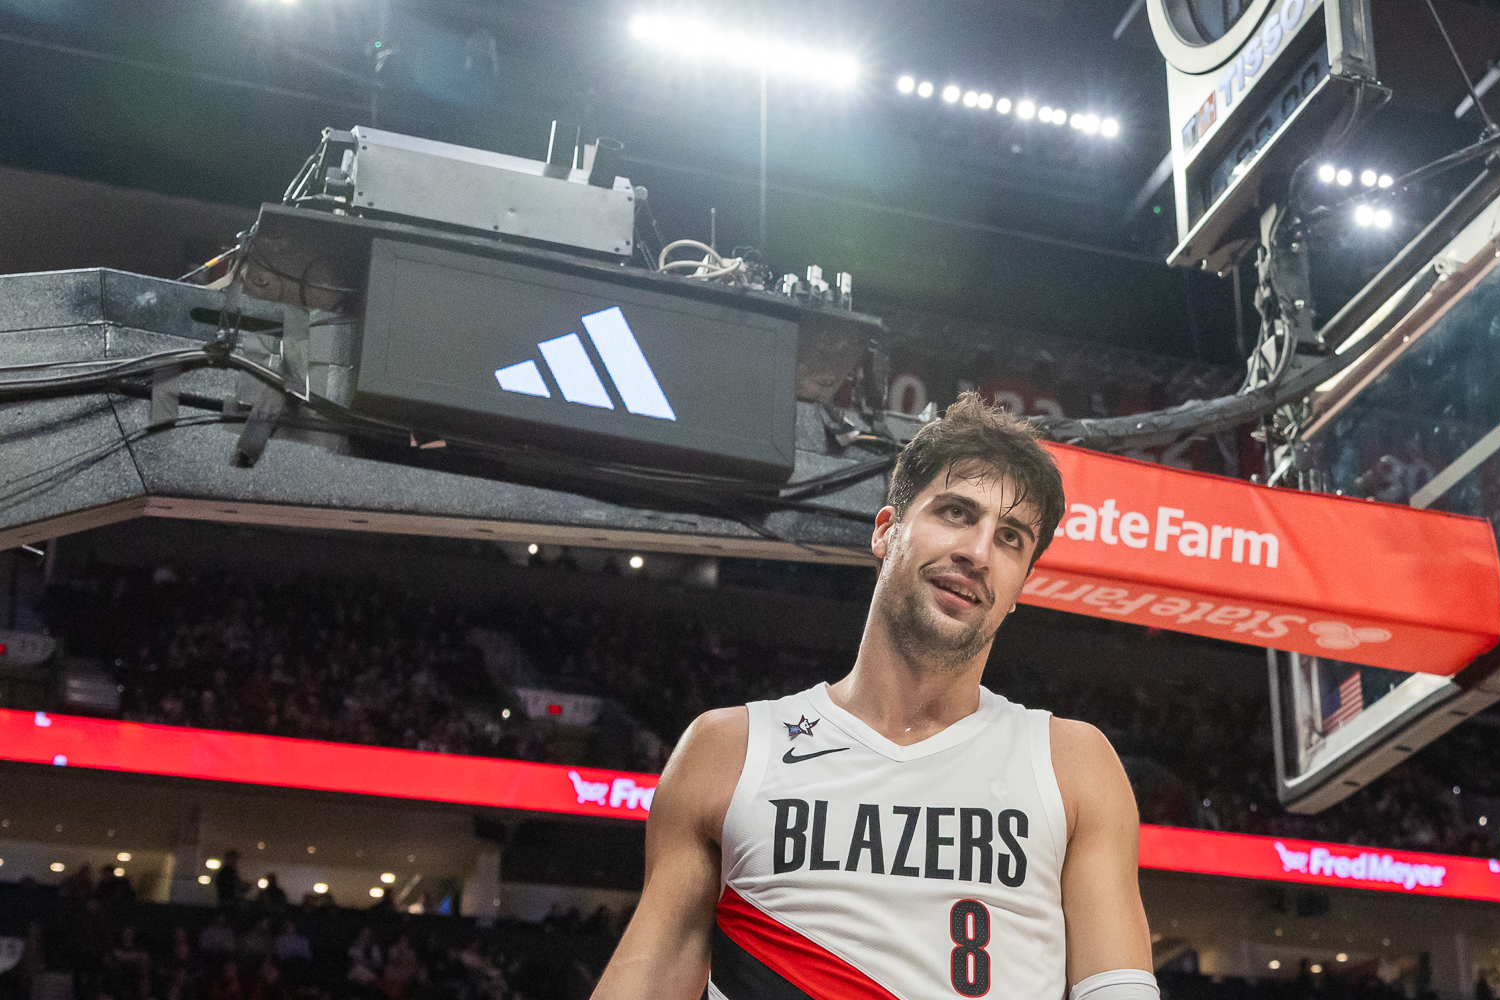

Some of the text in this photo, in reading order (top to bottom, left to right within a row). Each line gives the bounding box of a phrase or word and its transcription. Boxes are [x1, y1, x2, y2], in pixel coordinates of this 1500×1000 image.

[1217, 0, 1314, 107] TISSO
[1055, 498, 1279, 568] ateFarm
[769, 798, 1029, 888] BLAZERS
[950, 898, 991, 998] 8
